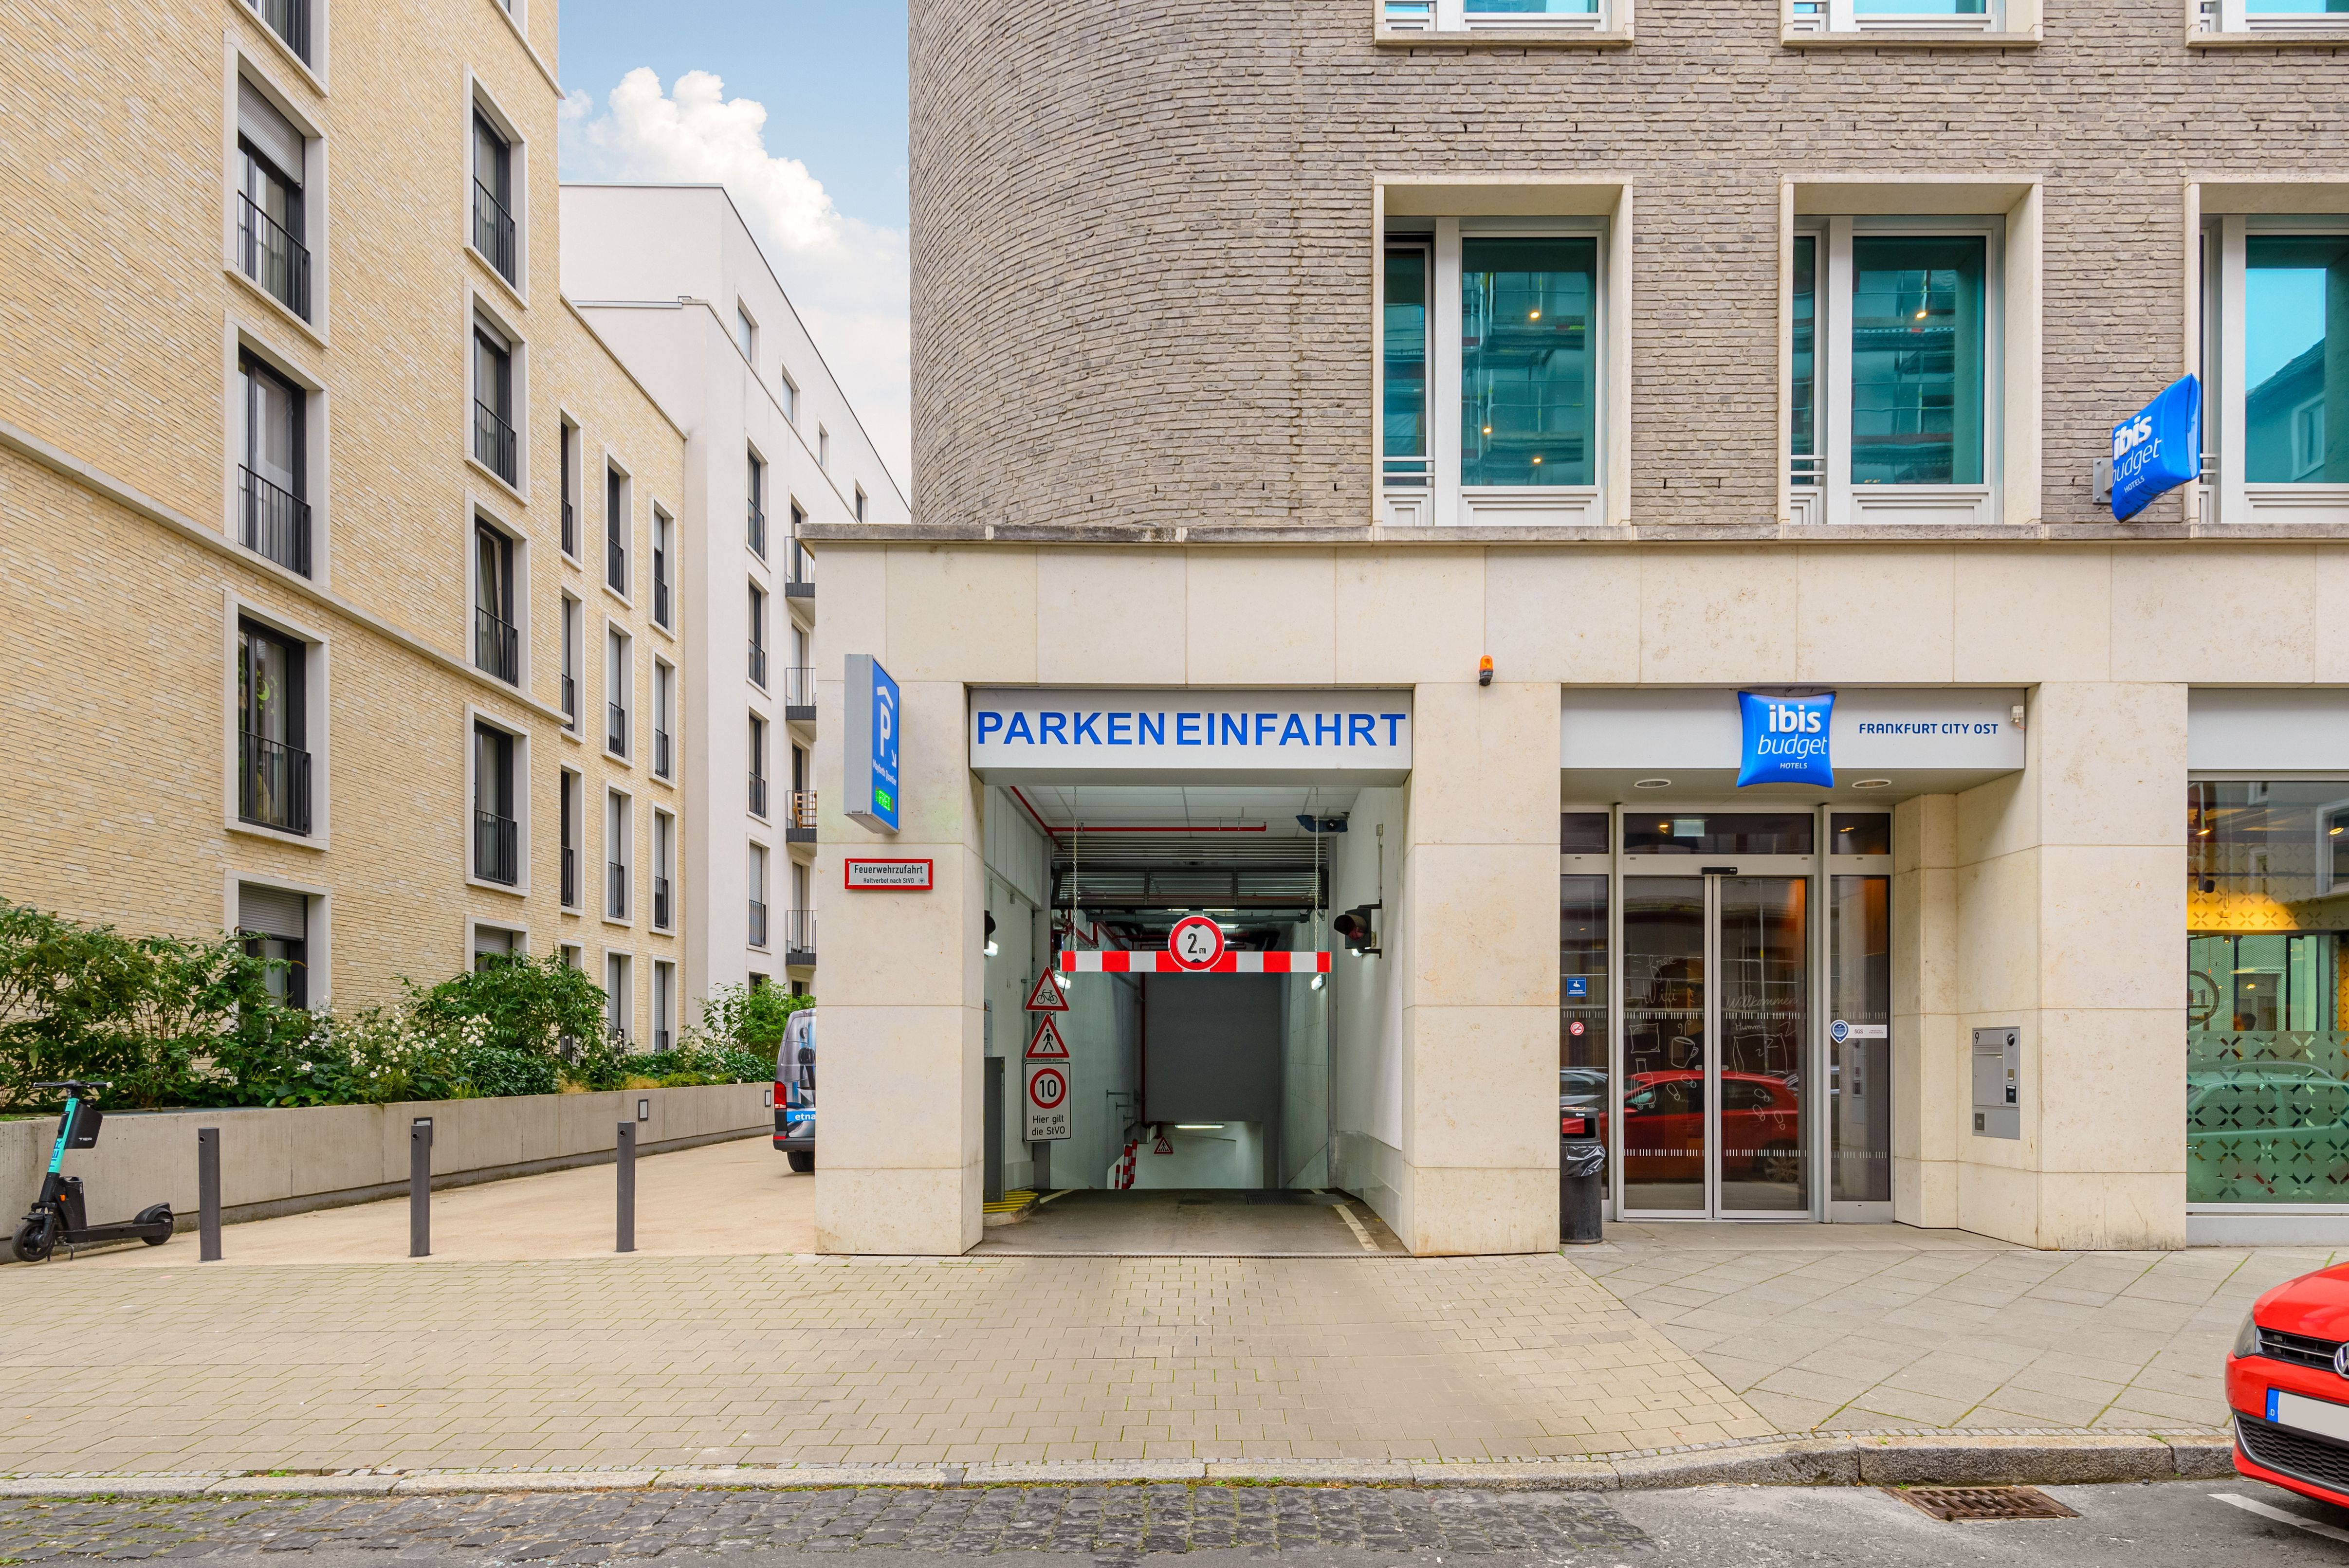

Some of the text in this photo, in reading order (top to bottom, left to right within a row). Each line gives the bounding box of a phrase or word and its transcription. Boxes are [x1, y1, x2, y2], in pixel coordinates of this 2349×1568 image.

[2114, 416, 2152, 460] ibis
[2124, 475, 2145, 493] HOTELS
[1769, 704, 1821, 733] ibis
[880, 701, 891, 757] P
[977, 711, 1406, 746] PARKEN EINFAHRT
[1859, 723, 1999, 734] FRANKFURT CITY OST
[1758, 734, 1827, 759] budget
[854, 864, 923, 874] Feuerwehrzufahrt
[1188, 933, 1198, 954] 2
[1646, 954, 1677, 983] free
[1726, 994, 1799, 1009] Willkommen
[1975, 1032, 1980, 1044] 9
[1039, 1079, 1057, 1098] 10
[1032, 1114, 1064, 1125] Hier gilt
[1031, 1126, 1065, 1136] die StVO
